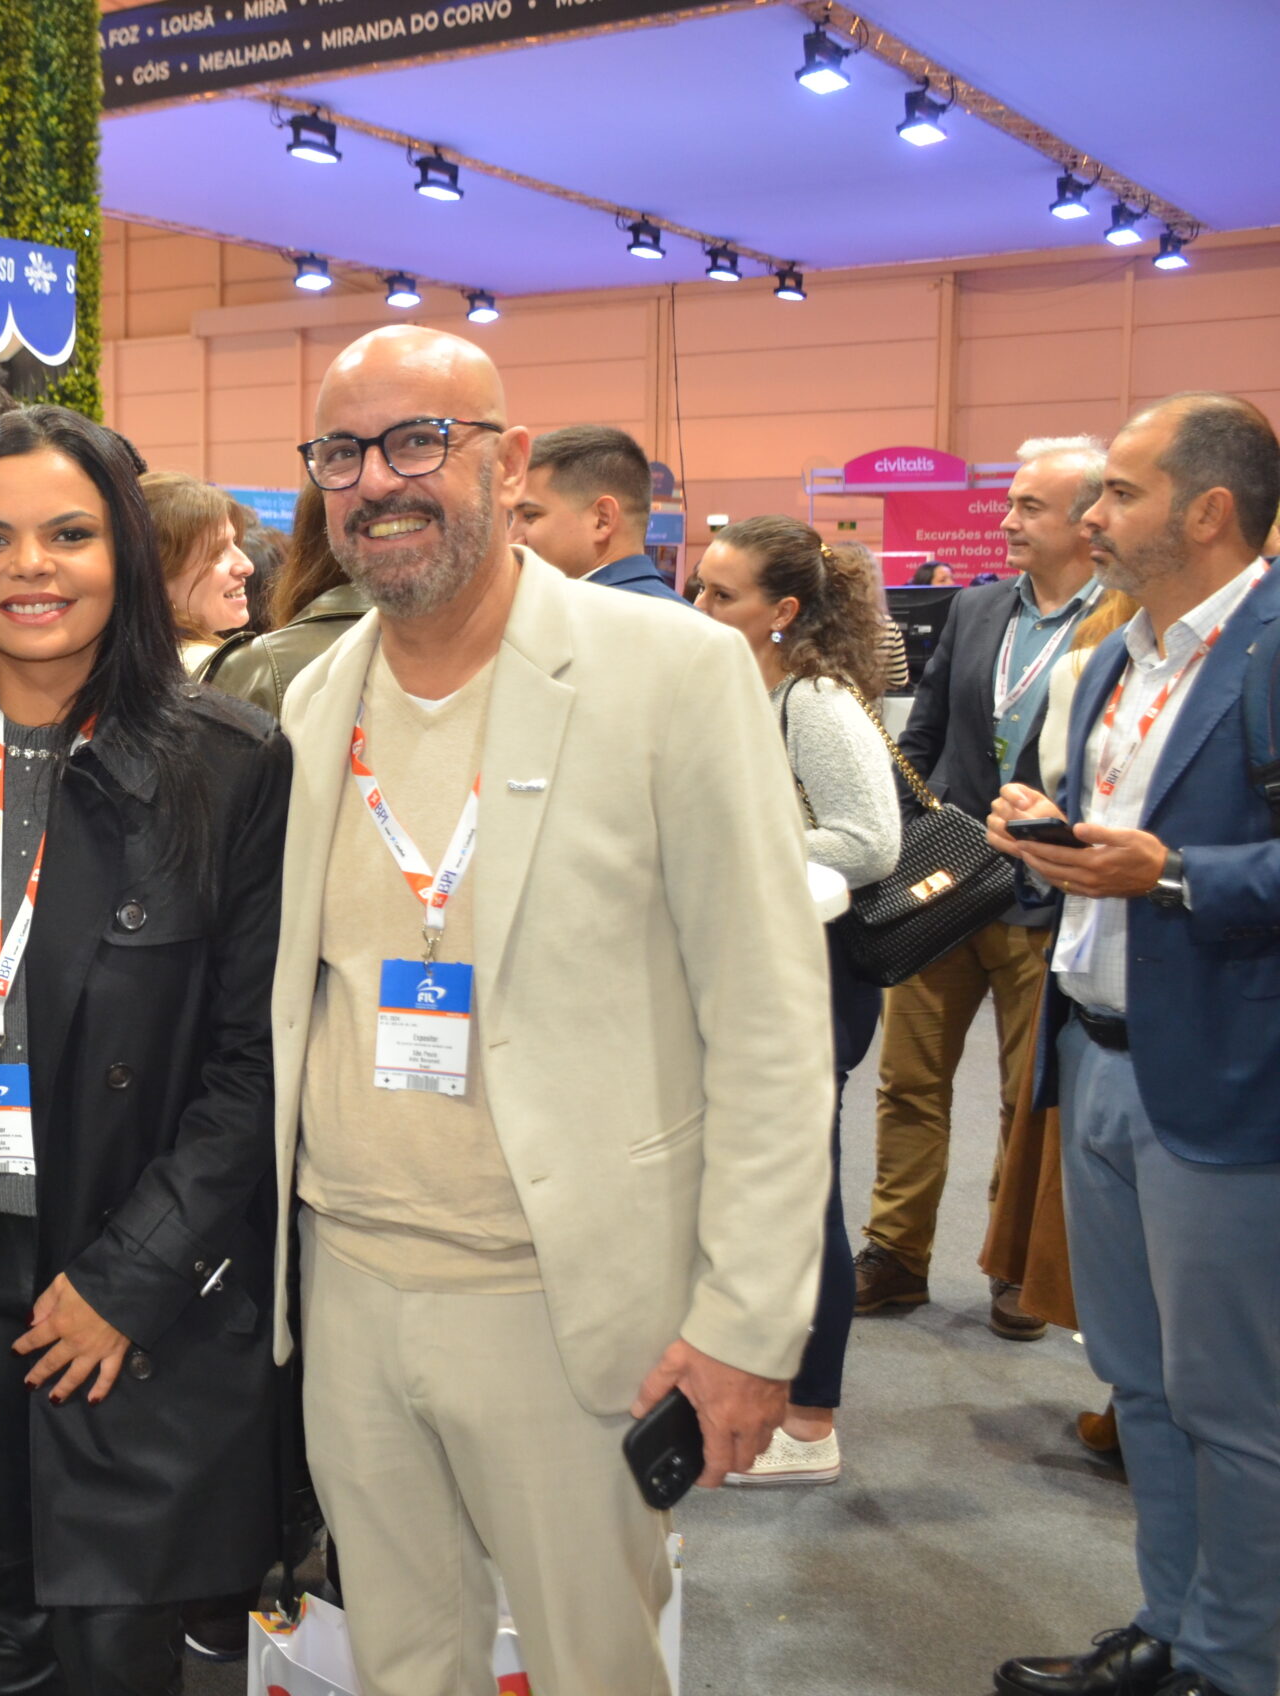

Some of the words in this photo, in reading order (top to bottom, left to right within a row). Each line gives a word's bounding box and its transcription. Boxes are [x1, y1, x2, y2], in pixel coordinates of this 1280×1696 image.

[108, 24, 140, 49] FOZ
[161, 4, 215, 37] LOUSÃ
[244, 0, 288, 21] MIRA
[132, 58, 170, 86] GÓIS
[199, 38, 293, 73] MEALHADA
[321, 17, 406, 50] MIRANDA
[410, 10, 439, 34] DO
[443, 0, 512, 28] CORVO
[874, 456, 935, 472] civitatis
[968, 500, 1010, 514] civita
[915, 528, 981, 541] Excursões
[937, 547, 957, 557] em
[961, 544, 991, 557] todo
[994, 547, 1004, 557] o
[1106, 767, 1121, 784] BPI
[374, 802, 389, 824] BPI
[437, 870, 457, 894] BPI
[417, 992, 435, 1003] FIL
